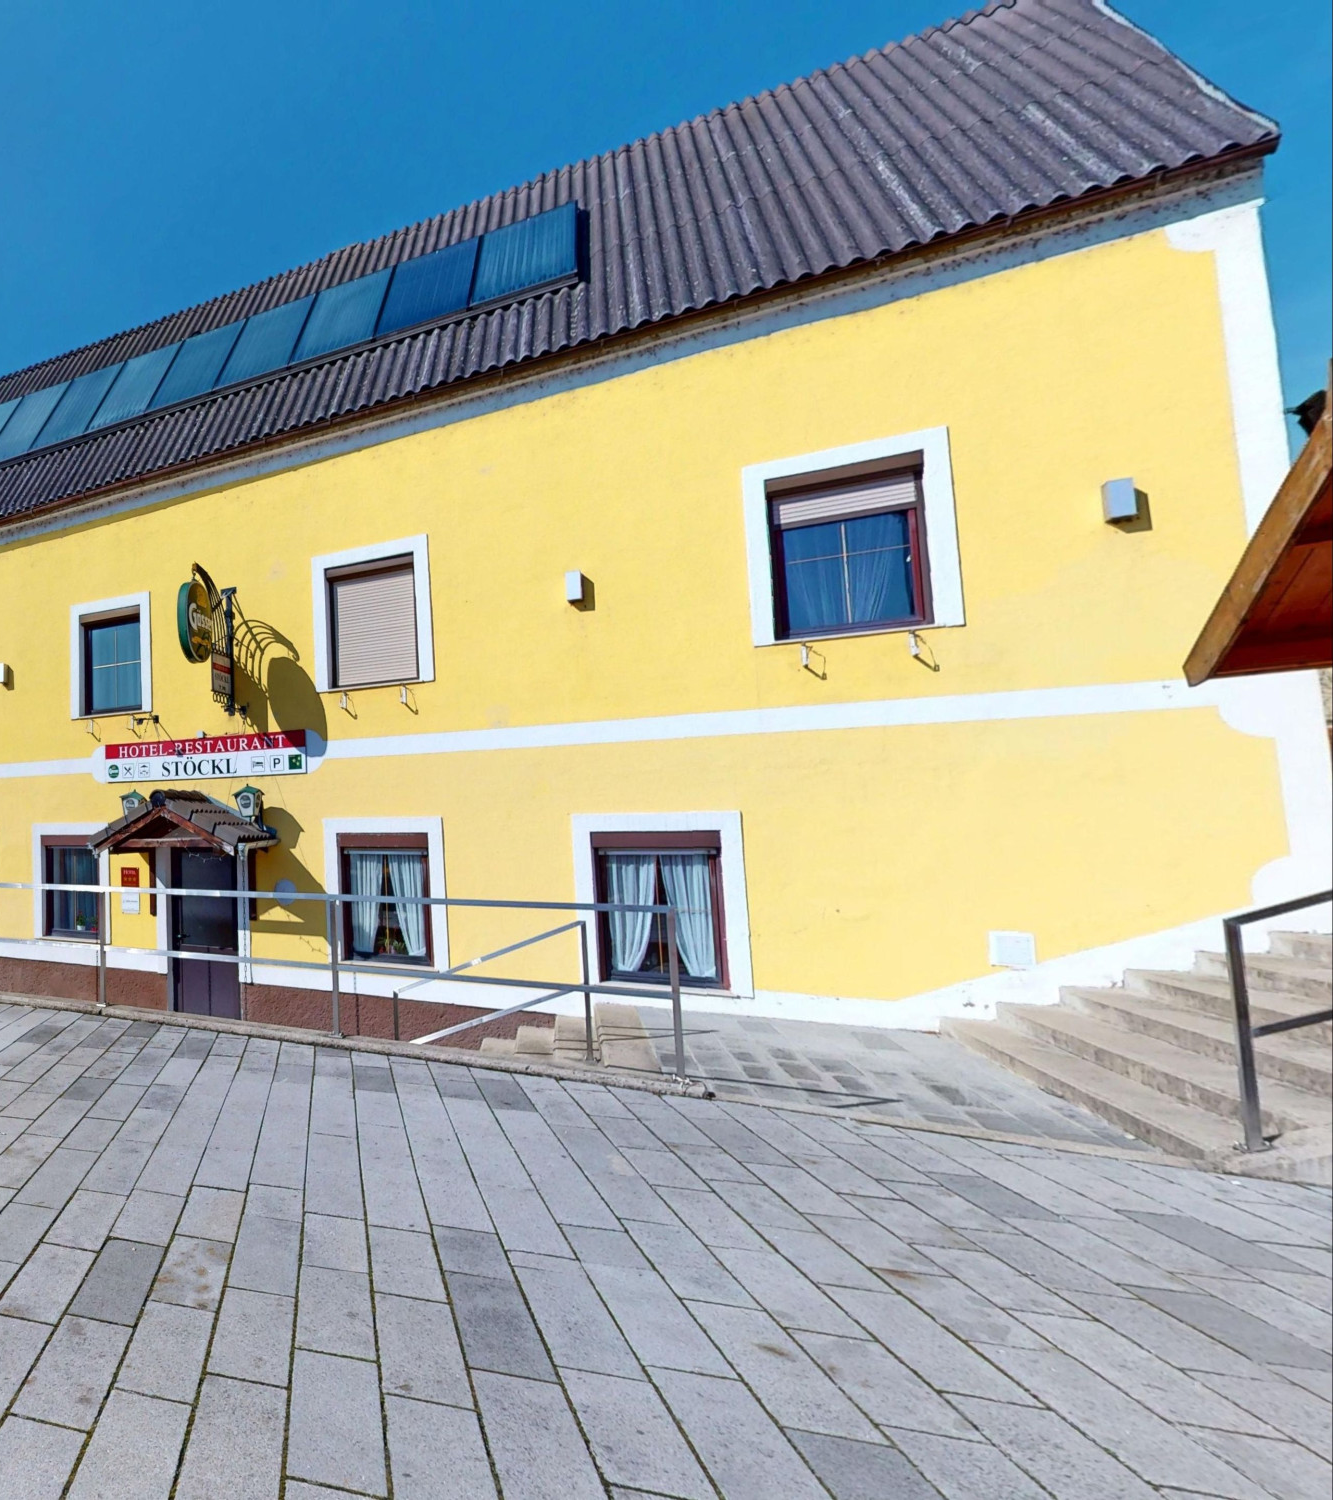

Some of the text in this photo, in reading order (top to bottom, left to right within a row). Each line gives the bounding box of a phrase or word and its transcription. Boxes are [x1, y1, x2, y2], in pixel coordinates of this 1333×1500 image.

[118, 734, 286, 758] HOTEL-RESTAURANT
[161, 757, 237, 777] STÖCKL
[273, 757, 281, 769] P
